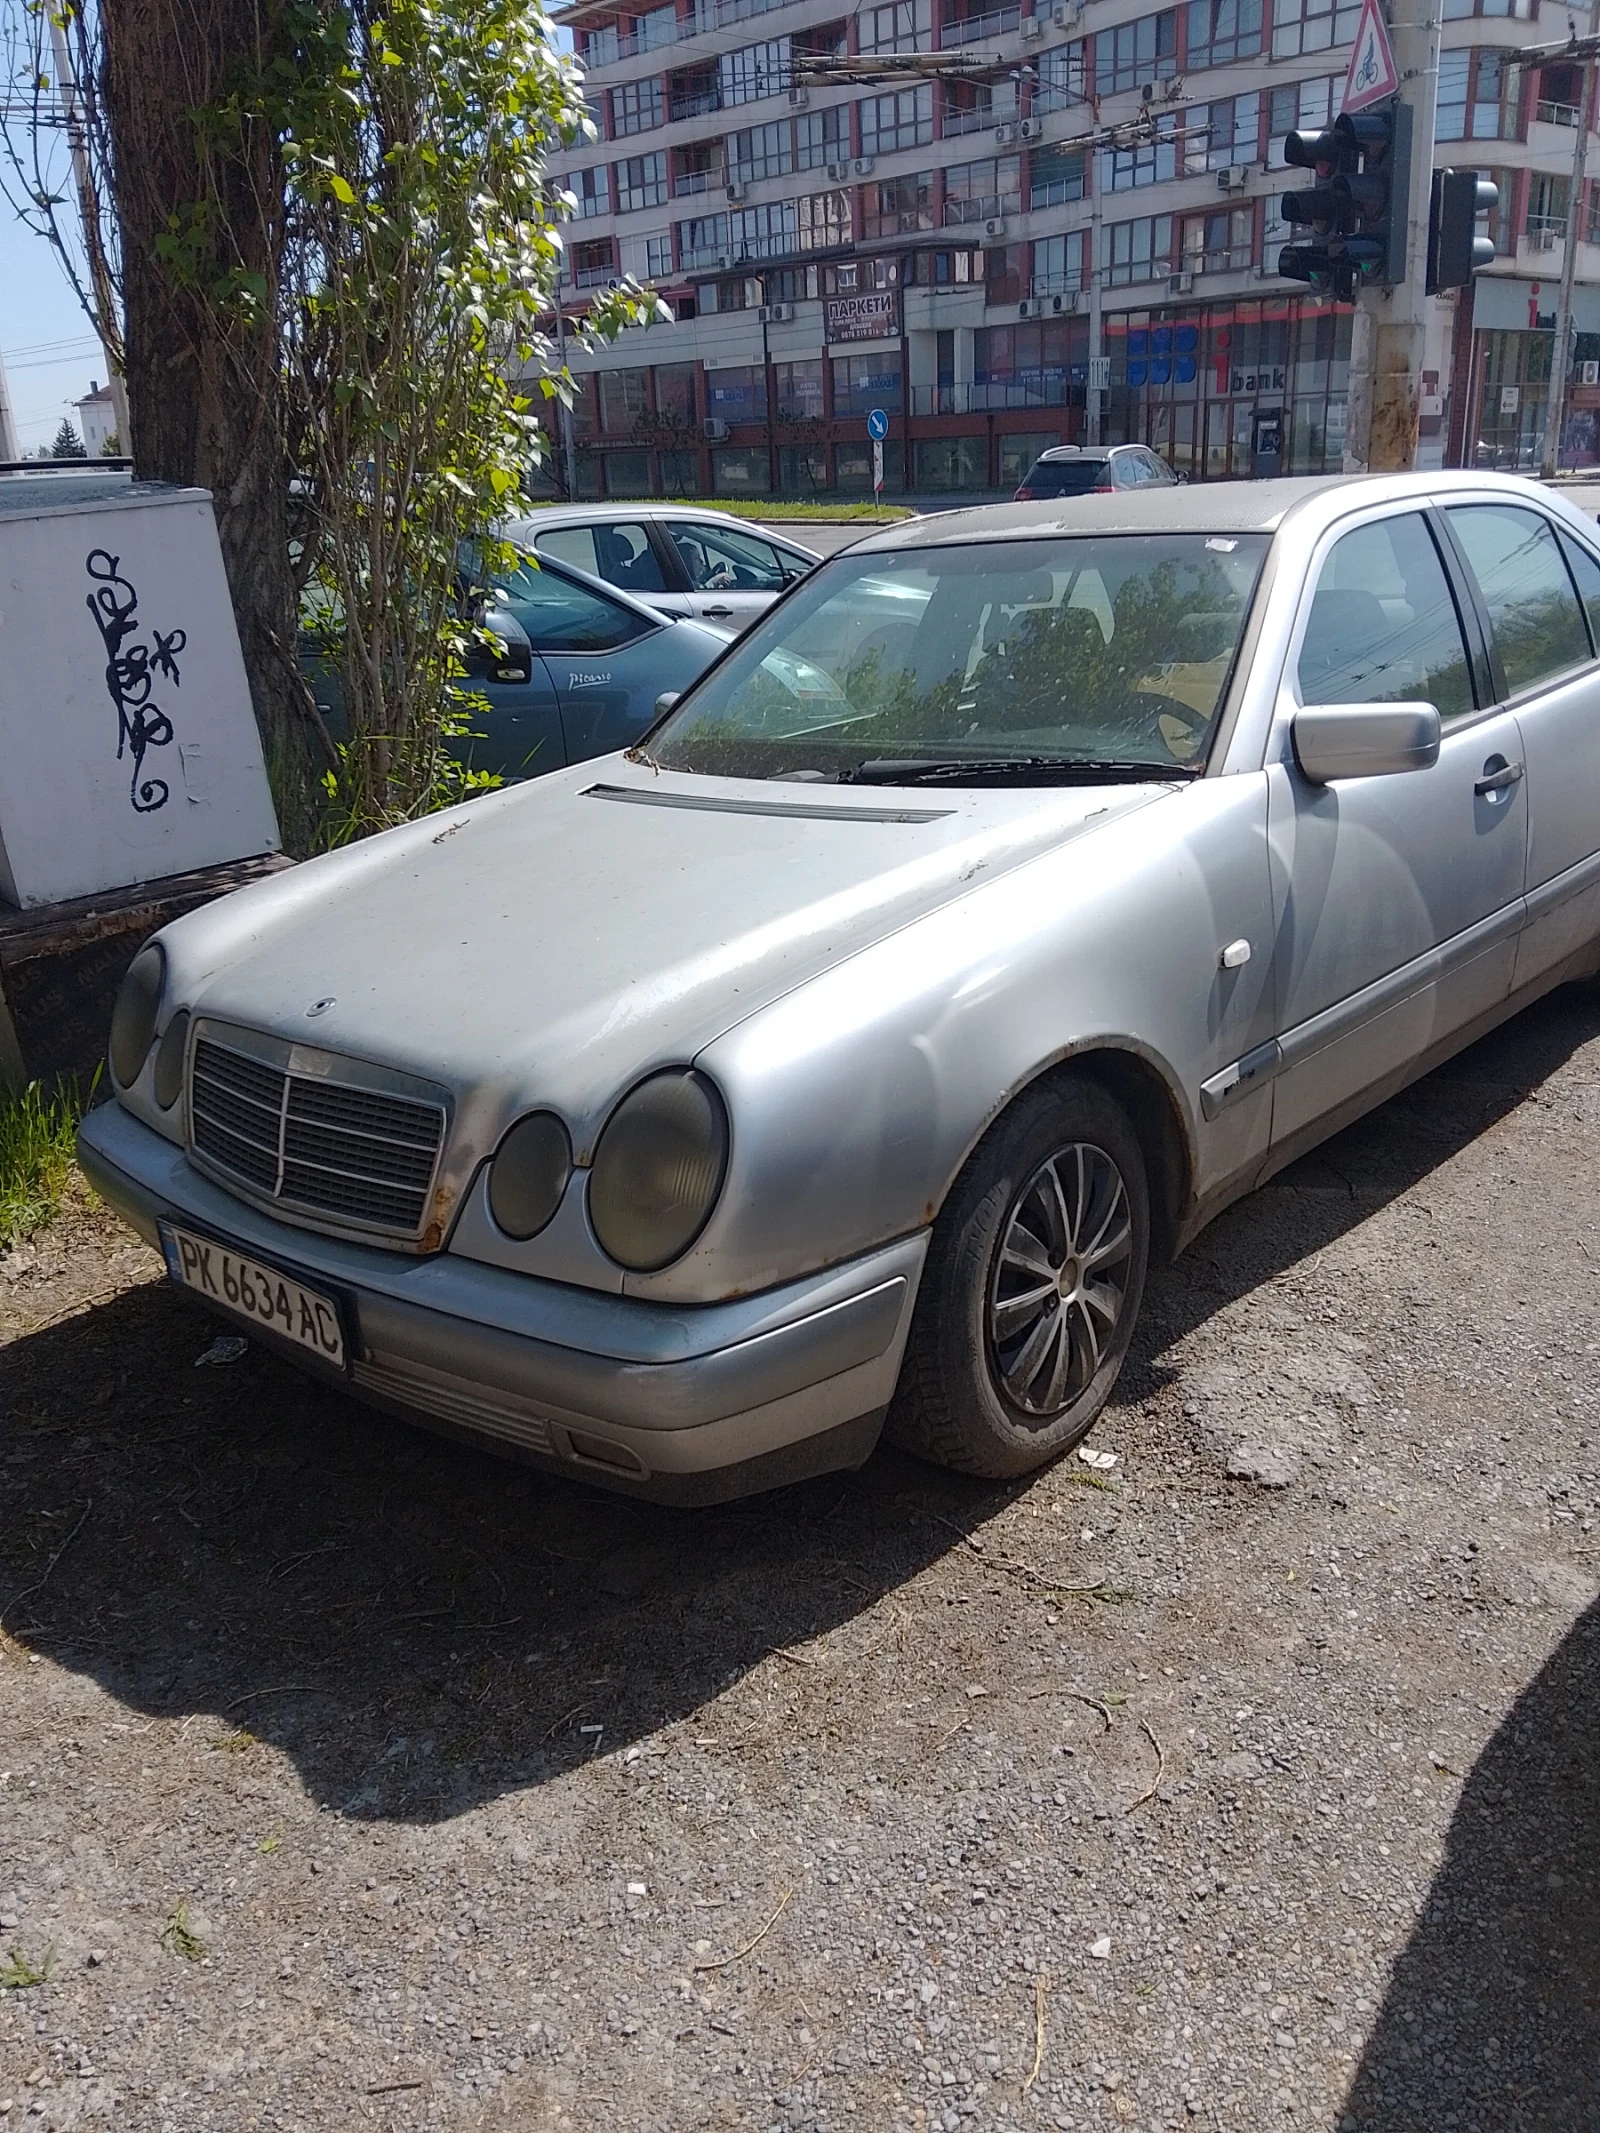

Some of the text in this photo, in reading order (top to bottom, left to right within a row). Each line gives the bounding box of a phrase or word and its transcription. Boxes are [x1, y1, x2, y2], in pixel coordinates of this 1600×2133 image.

[829, 293, 892, 318] ПАРКЕТИ
[178, 1236, 338, 1353] PK 6634 AC
